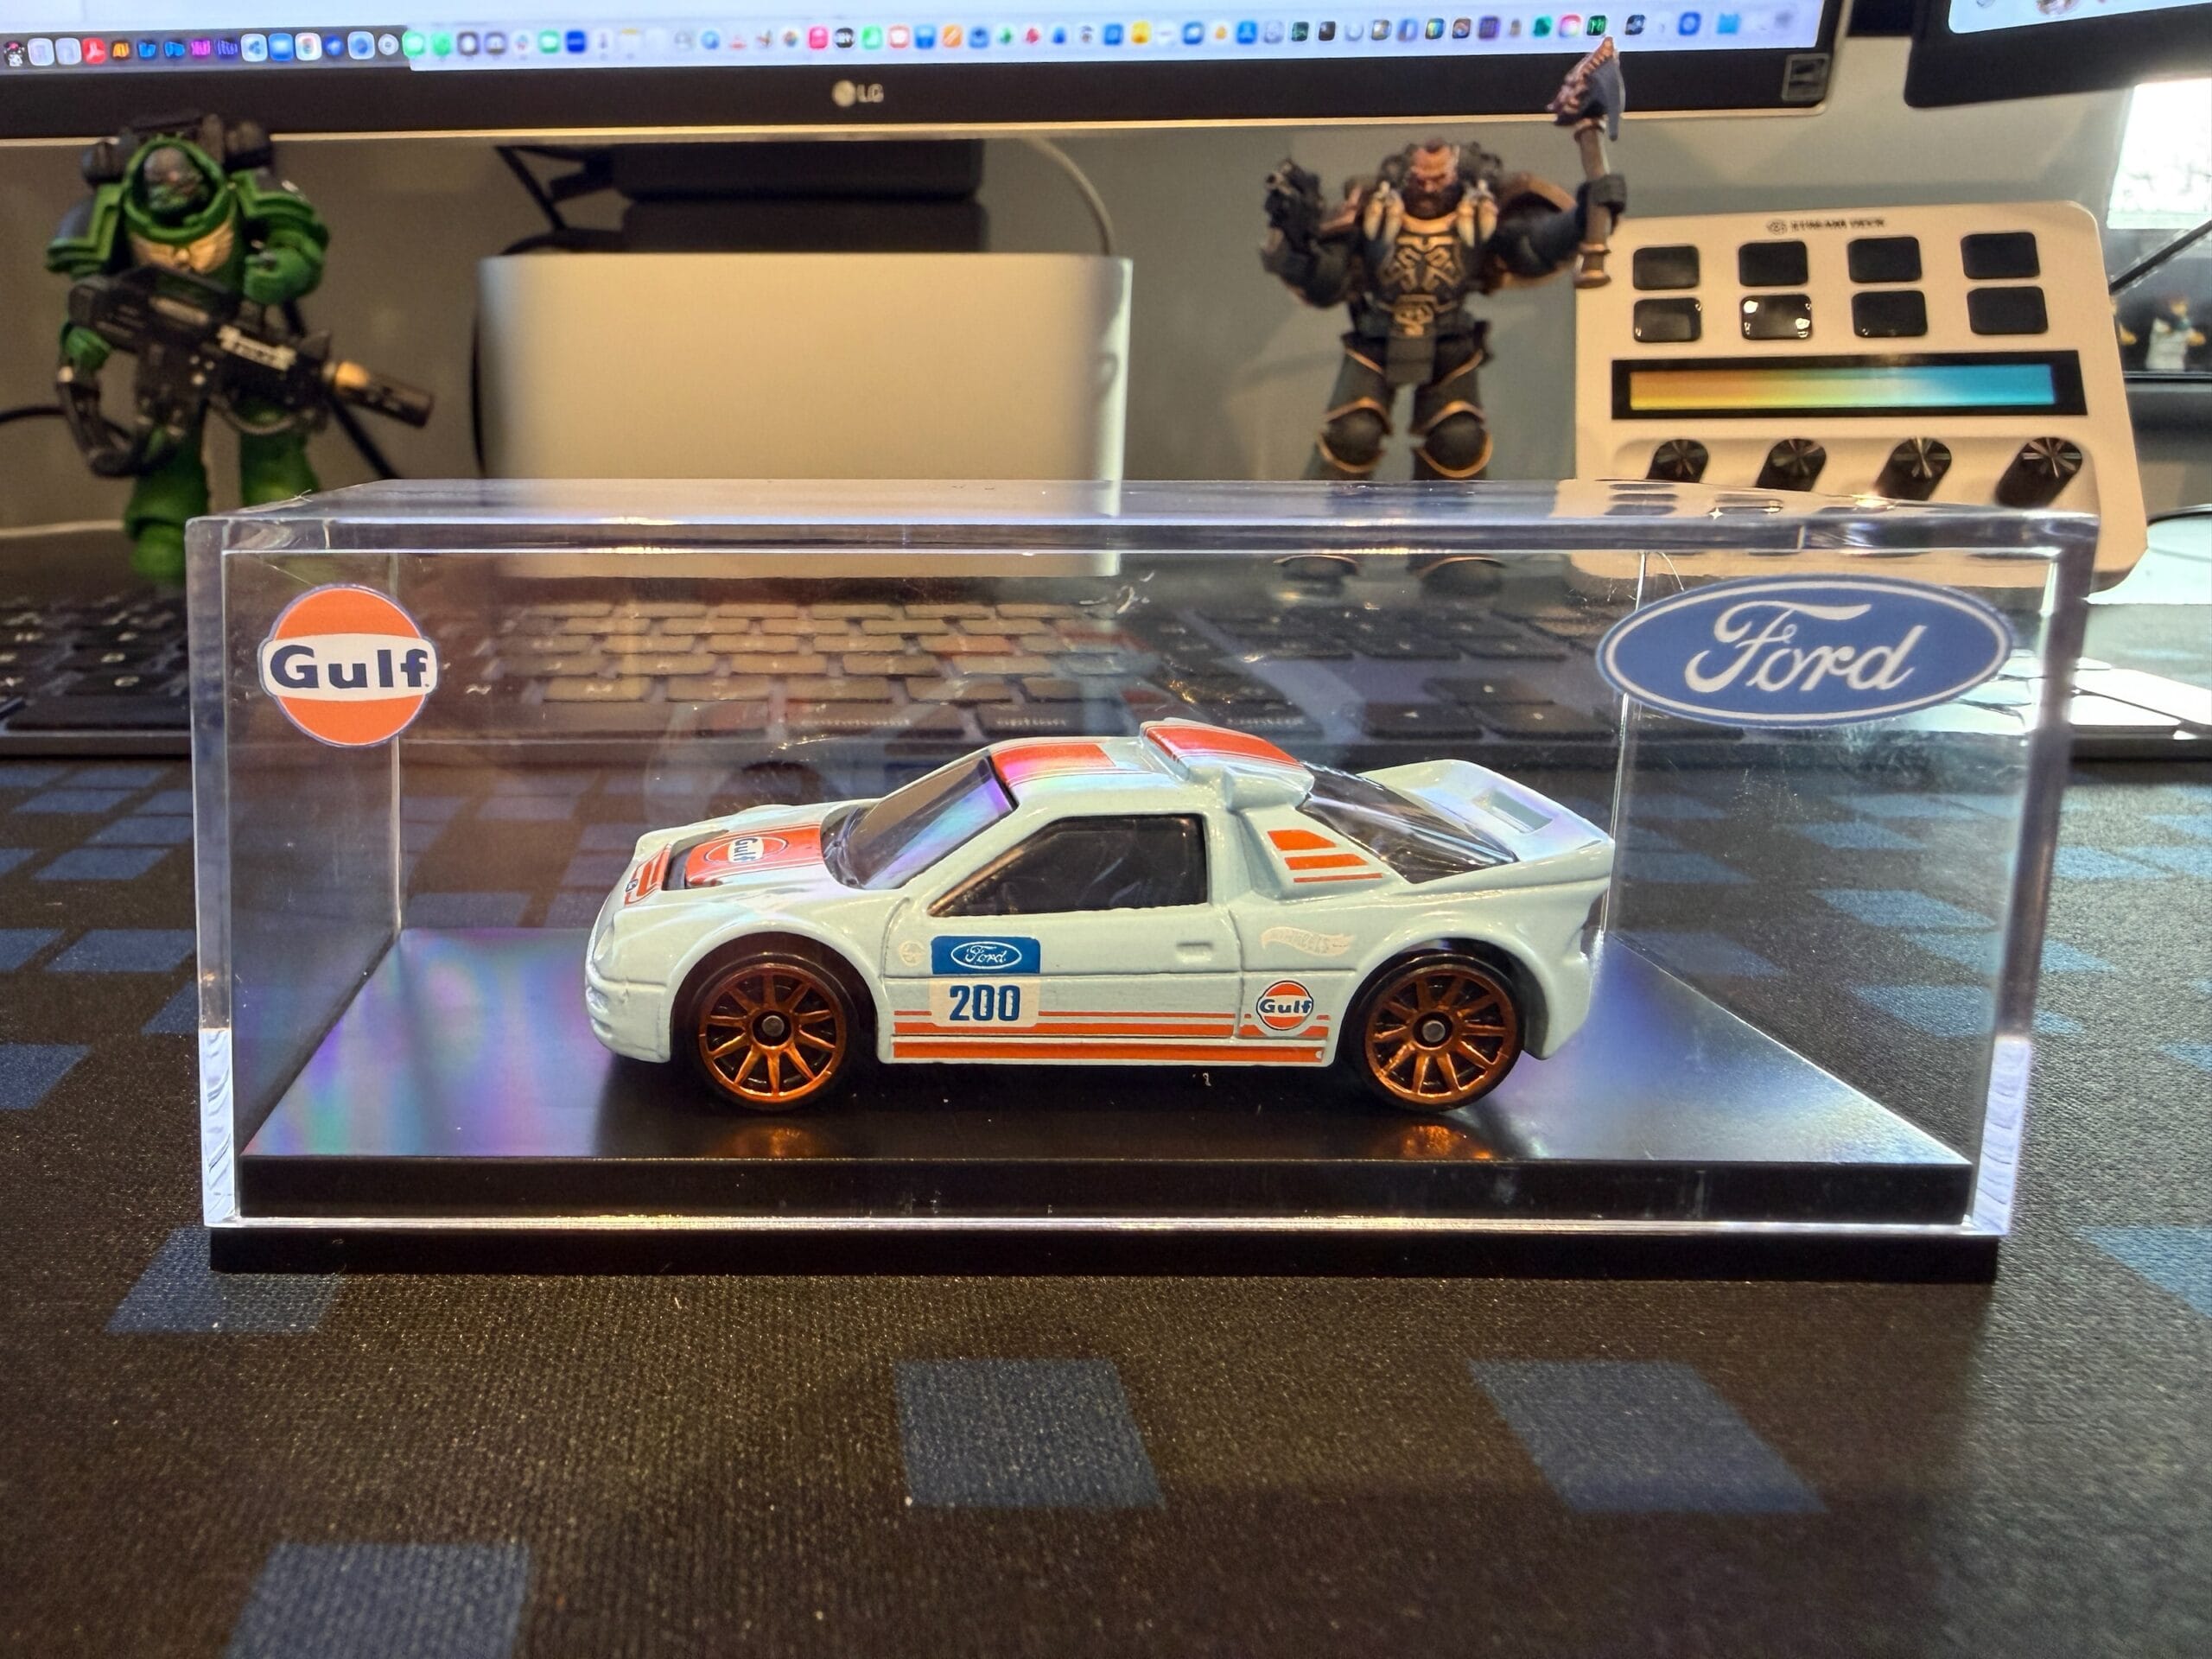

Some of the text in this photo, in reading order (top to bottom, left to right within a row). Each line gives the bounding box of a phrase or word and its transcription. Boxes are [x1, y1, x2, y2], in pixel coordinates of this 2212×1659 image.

[856, 83, 885, 103] LG
[1684, 600, 1928, 693] Ford
[270, 644, 429, 689] Gulf
[734, 838, 758, 861] Gulf
[965, 944, 1007, 964] Ford
[950, 984, 1021, 1022] 200
[1259, 998, 1313, 1014] Gulf
